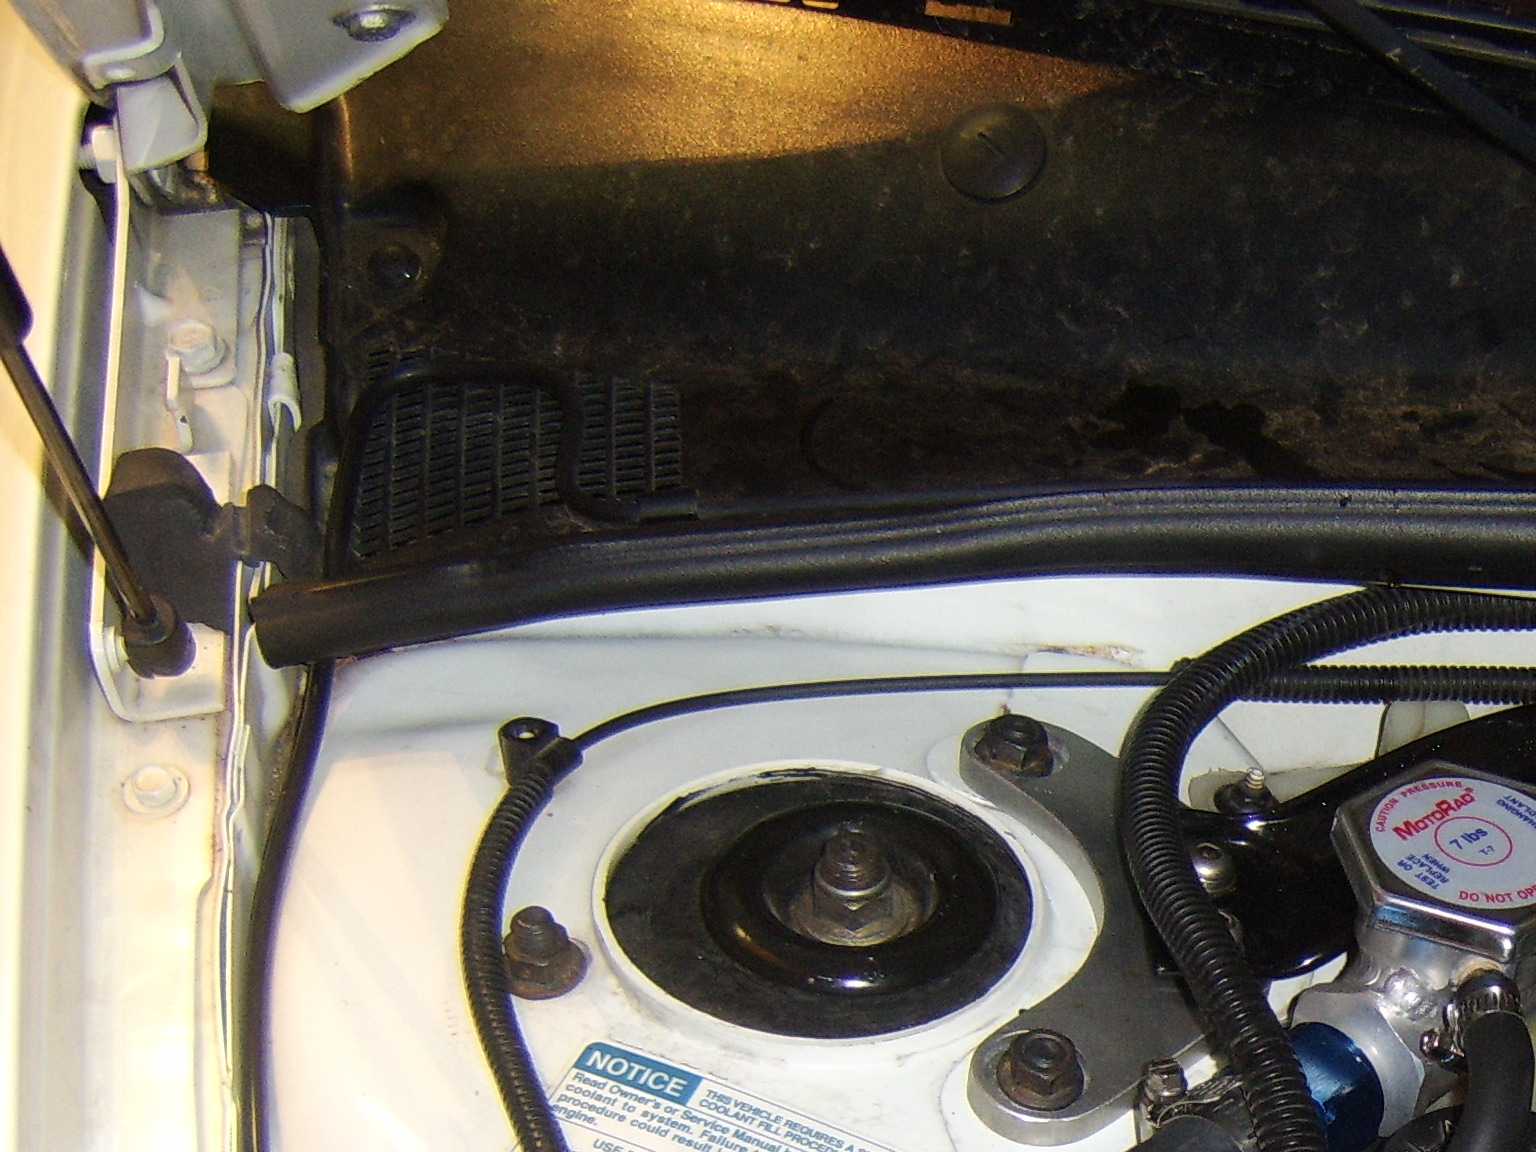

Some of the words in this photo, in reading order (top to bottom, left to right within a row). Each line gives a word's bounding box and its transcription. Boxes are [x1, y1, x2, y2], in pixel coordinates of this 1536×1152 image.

[1375, 797, 1400, 833] CAUTION
[1449, 837, 1464, 851] 7
[1461, 827, 1489, 845] lbs
[1458, 890, 1480, 903] DO
[1485, 892, 1514, 904] NOT
[586, 1051, 687, 1096] NOTICE
[552, 1104, 598, 1127] engine.
[555, 1093, 627, 1123] procedure
[629, 1118, 670, 1138] could
[564, 1083, 618, 1107] coolant
[621, 1101, 637, 1114] to
[639, 1109, 693, 1136] system.
[571, 1071, 608, 1091] Read
[608, 1084, 663, 1110] Owner's
[663, 1105, 680, 1116] or
[679, 1109, 731, 1135] Service
[698, 1098, 757, 1125] COOLANT
[756, 1120, 781, 1136] FILL
[705, 1089, 733, 1105] THIS
[733, 1099, 783, 1124] VEHICLE
[782, 1119, 845, 1149] REQUIRES
[844, 1144, 855, 1152] A
